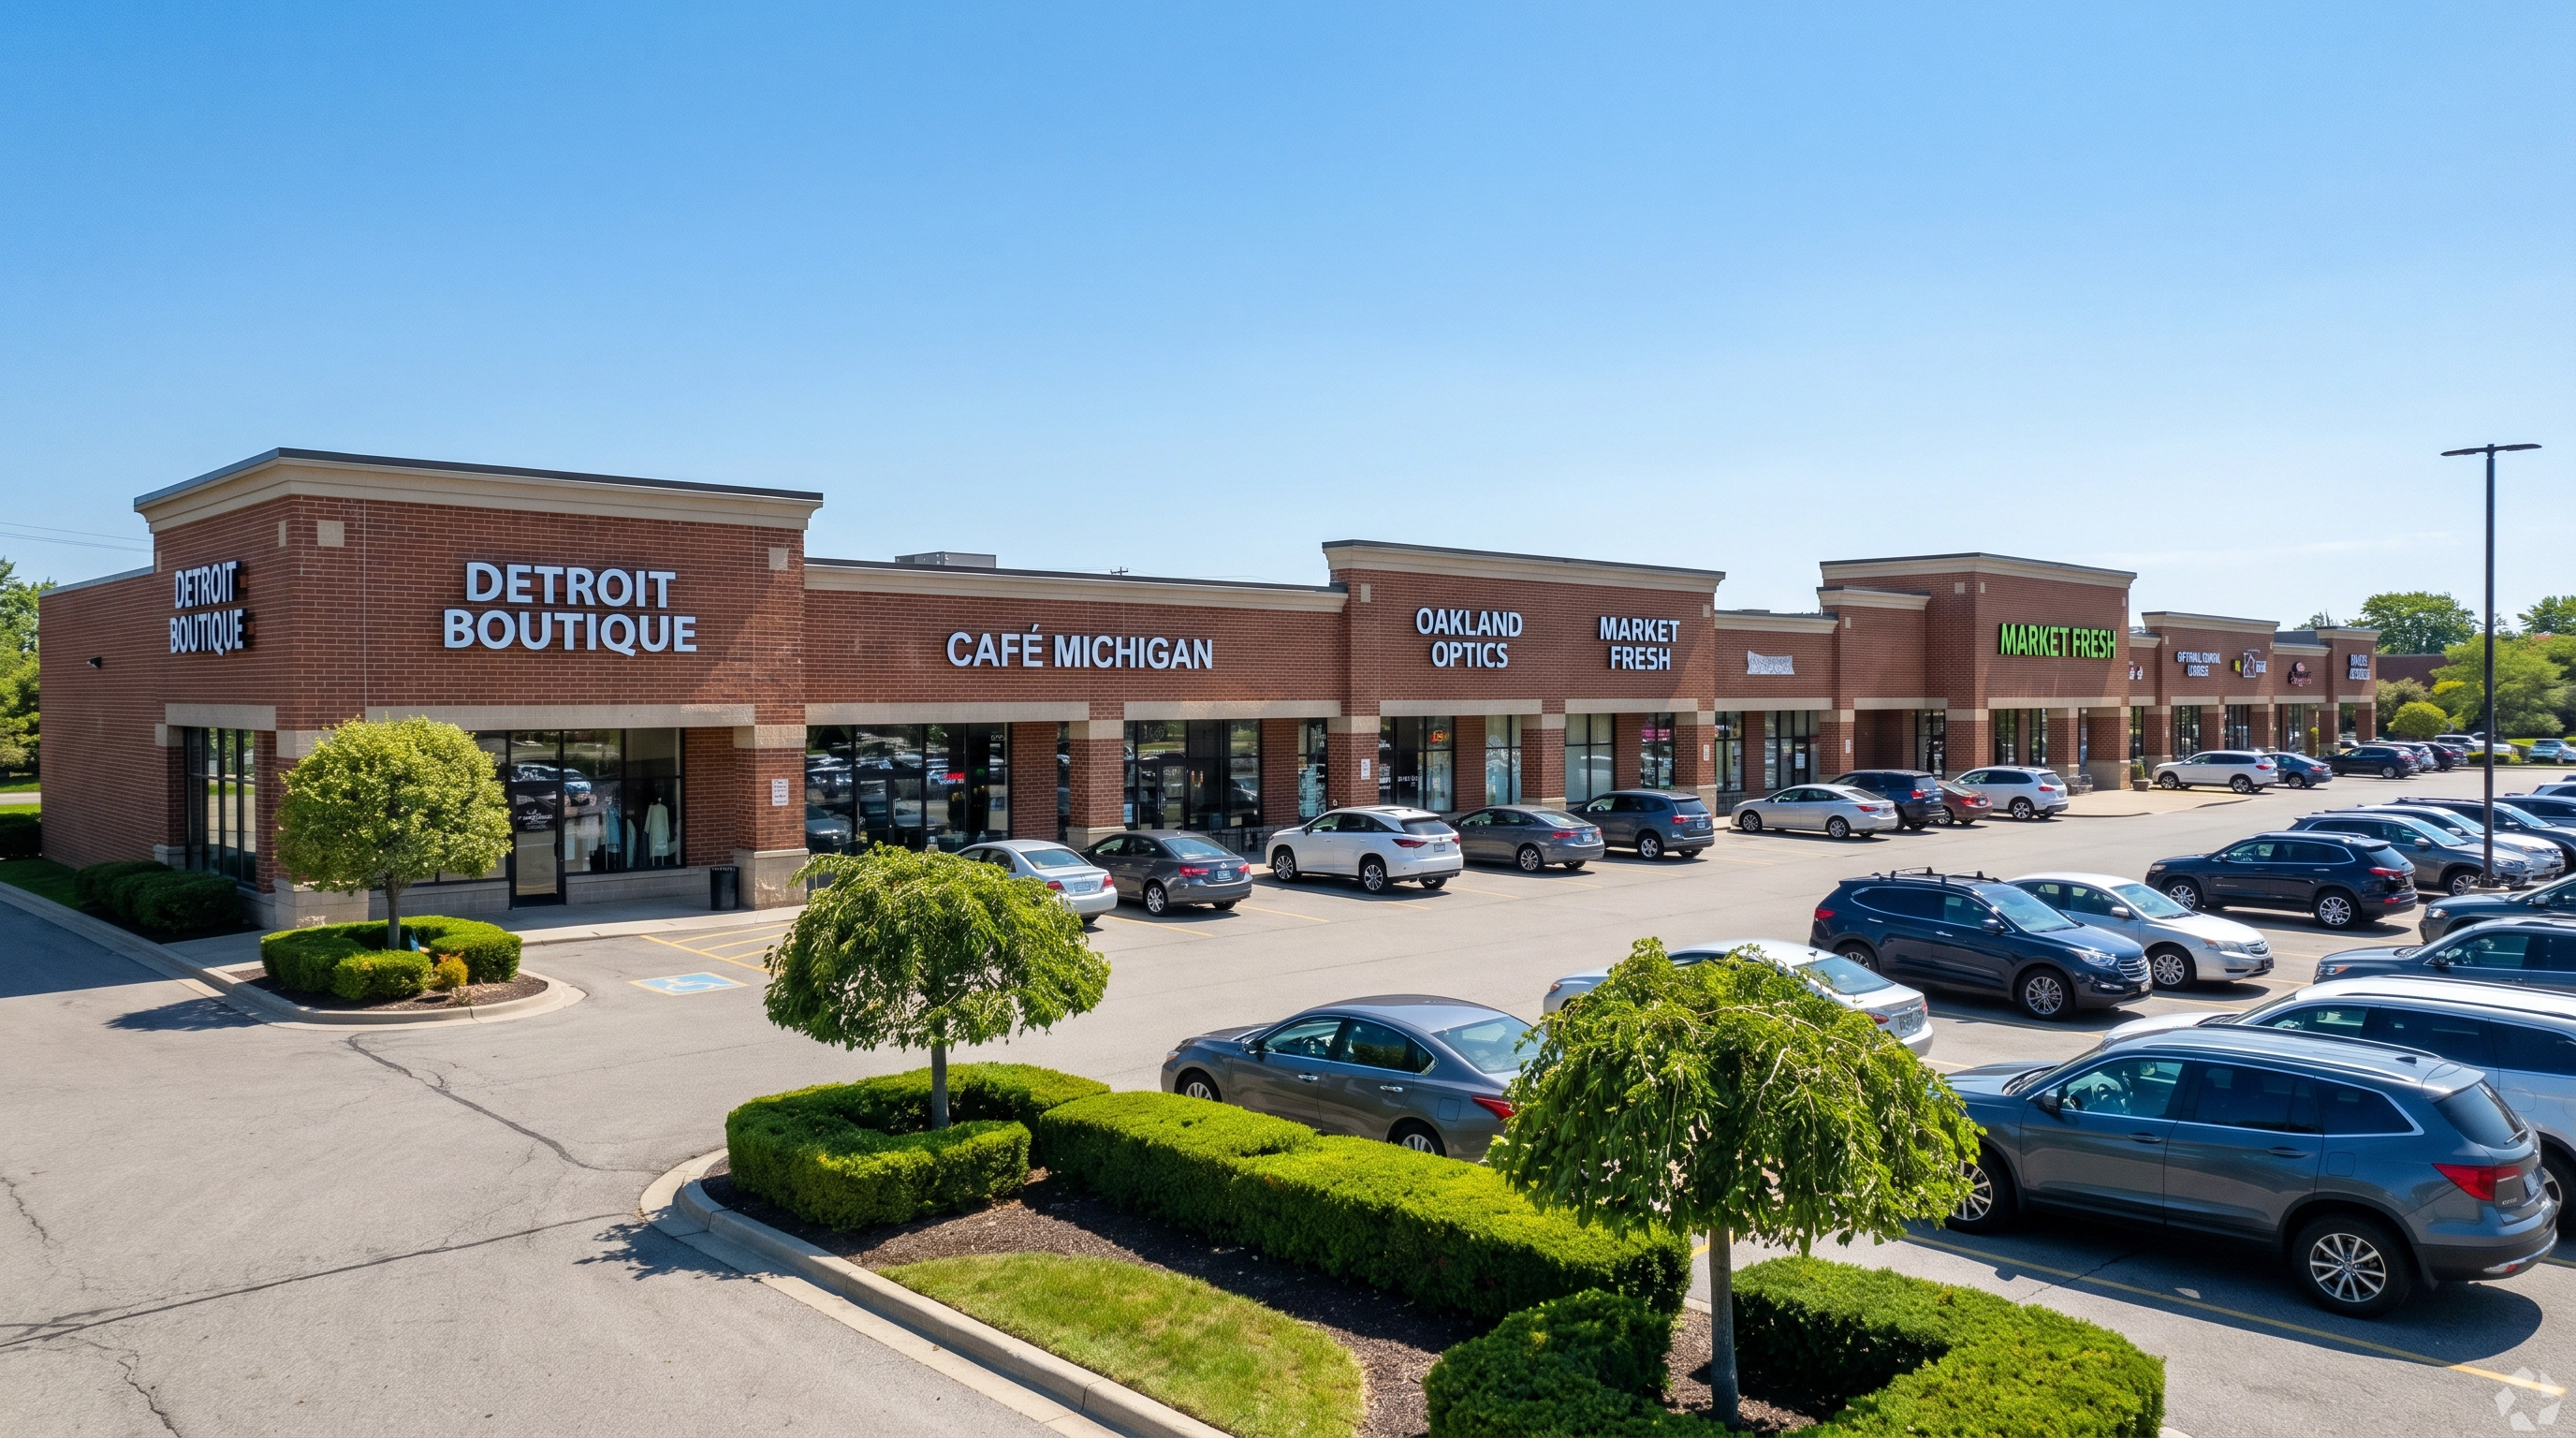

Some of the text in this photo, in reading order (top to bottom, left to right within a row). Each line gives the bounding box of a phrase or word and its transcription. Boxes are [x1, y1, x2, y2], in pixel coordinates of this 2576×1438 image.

[175, 561, 237, 609] DETROIT
[466, 562, 676, 609] DETROIT
[169, 609, 243, 656] BOUTIQUE
[444, 609, 697, 656] BOUTIQUE
[1416, 607, 1523, 638] OAKLAND
[1600, 616, 1680, 642] MARKET
[2000, 623, 2116, 659] MARKET FRESH
[946, 624, 1213, 669] CAFÉ MICHIGAN
[1431, 640, 1509, 668] OPTICS
[1611, 646, 1671, 670] FRESH
